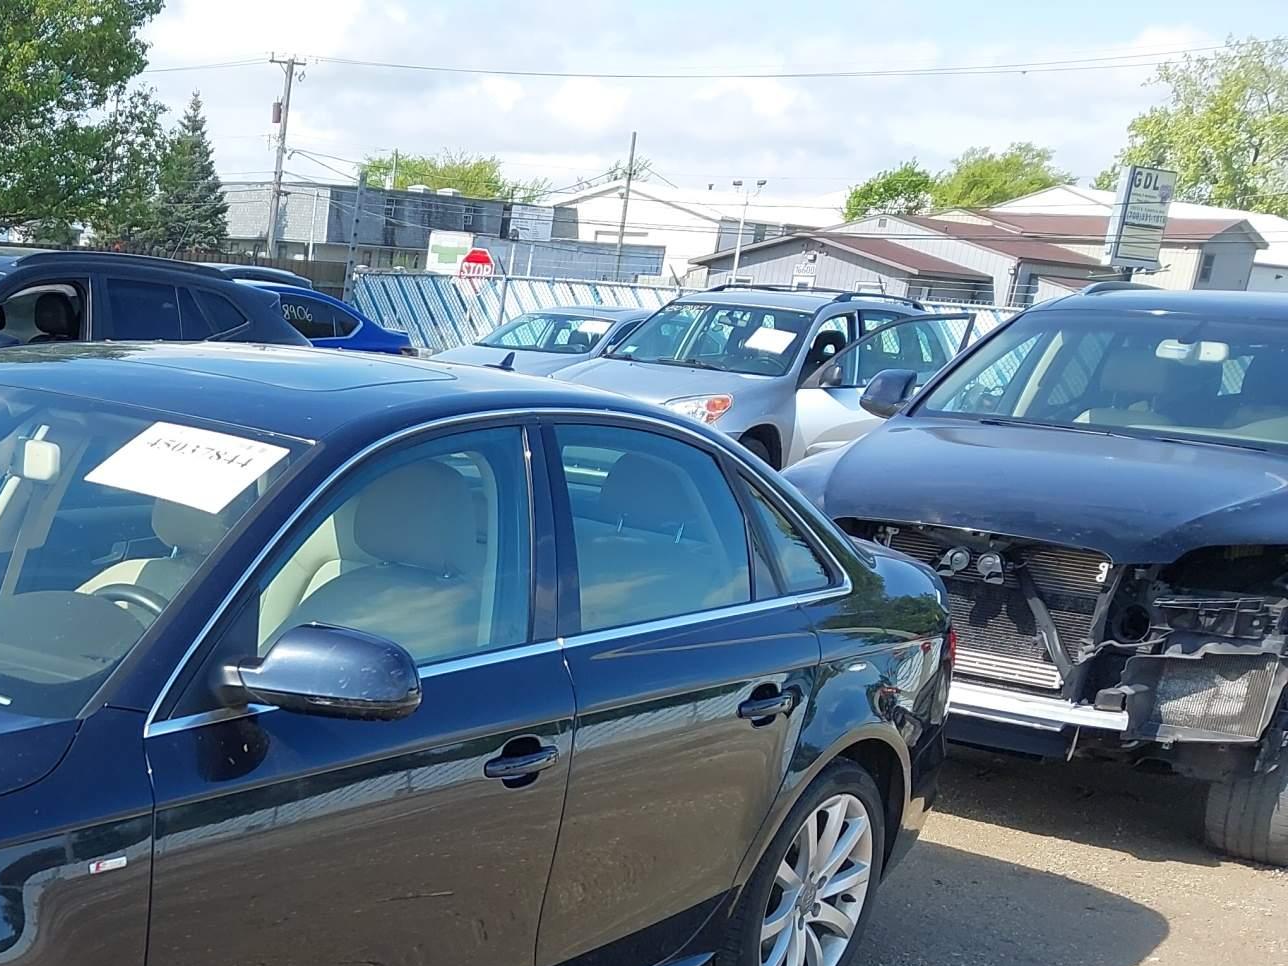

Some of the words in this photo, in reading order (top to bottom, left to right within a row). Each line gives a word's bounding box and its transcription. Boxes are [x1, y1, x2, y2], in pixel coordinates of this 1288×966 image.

[1133, 171, 1160, 191] GDL
[460, 262, 492, 278] STOP
[282, 304, 313, 322] 8906
